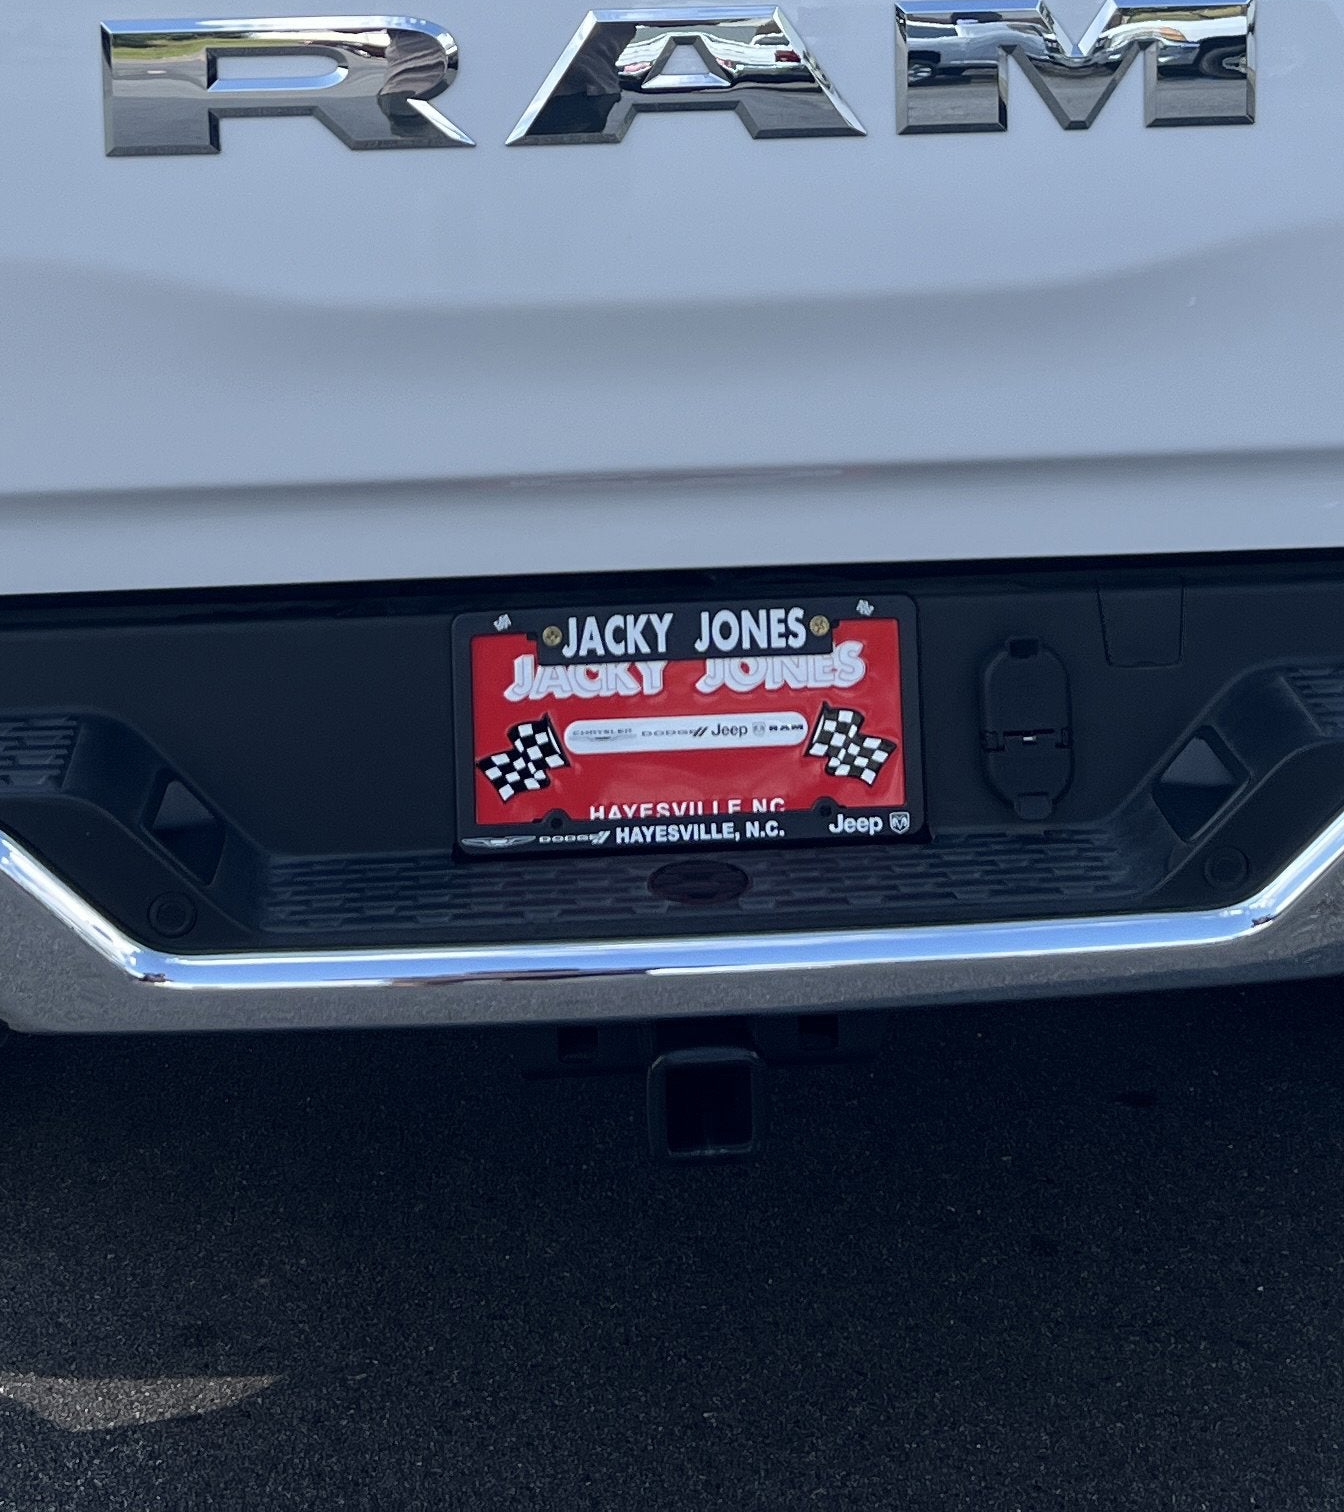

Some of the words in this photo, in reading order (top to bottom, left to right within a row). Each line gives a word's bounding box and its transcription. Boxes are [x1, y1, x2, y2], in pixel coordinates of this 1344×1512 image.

[562, 612, 674, 658] JACKY
[694, 607, 807, 653] JONES
[503, 652, 668, 702] JACKY
[695, 640, 866, 694] JONES
[711, 723, 749, 737] Jeep
[769, 723, 805, 731] RAM
[615, 821, 740, 845] HAYESVILLE,
[745, 820, 786, 839] N.C.
[828, 813, 884, 836] Jeep
